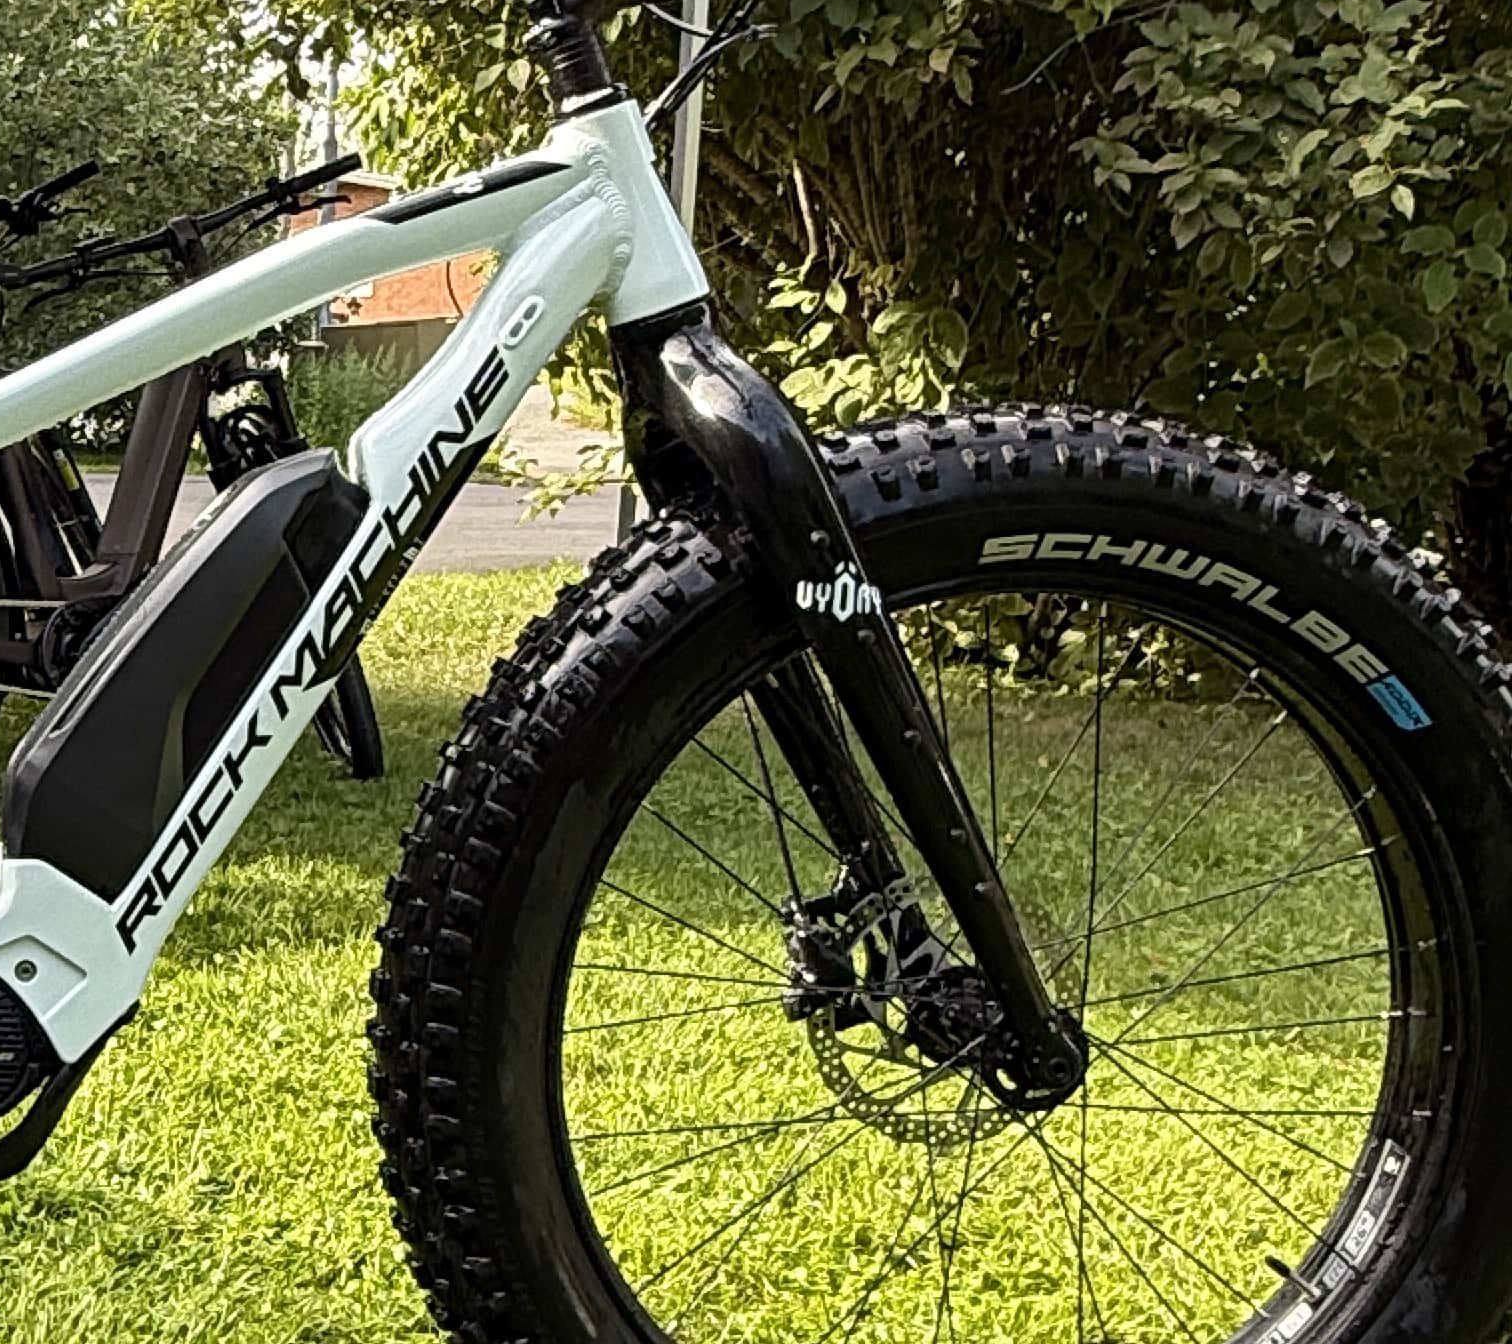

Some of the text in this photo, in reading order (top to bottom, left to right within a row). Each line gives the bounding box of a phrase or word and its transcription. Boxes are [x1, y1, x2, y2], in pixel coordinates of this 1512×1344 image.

[114, 345, 511, 956] ROCK MACHINE
[978, 532, 1391, 686] SCHWALBE
